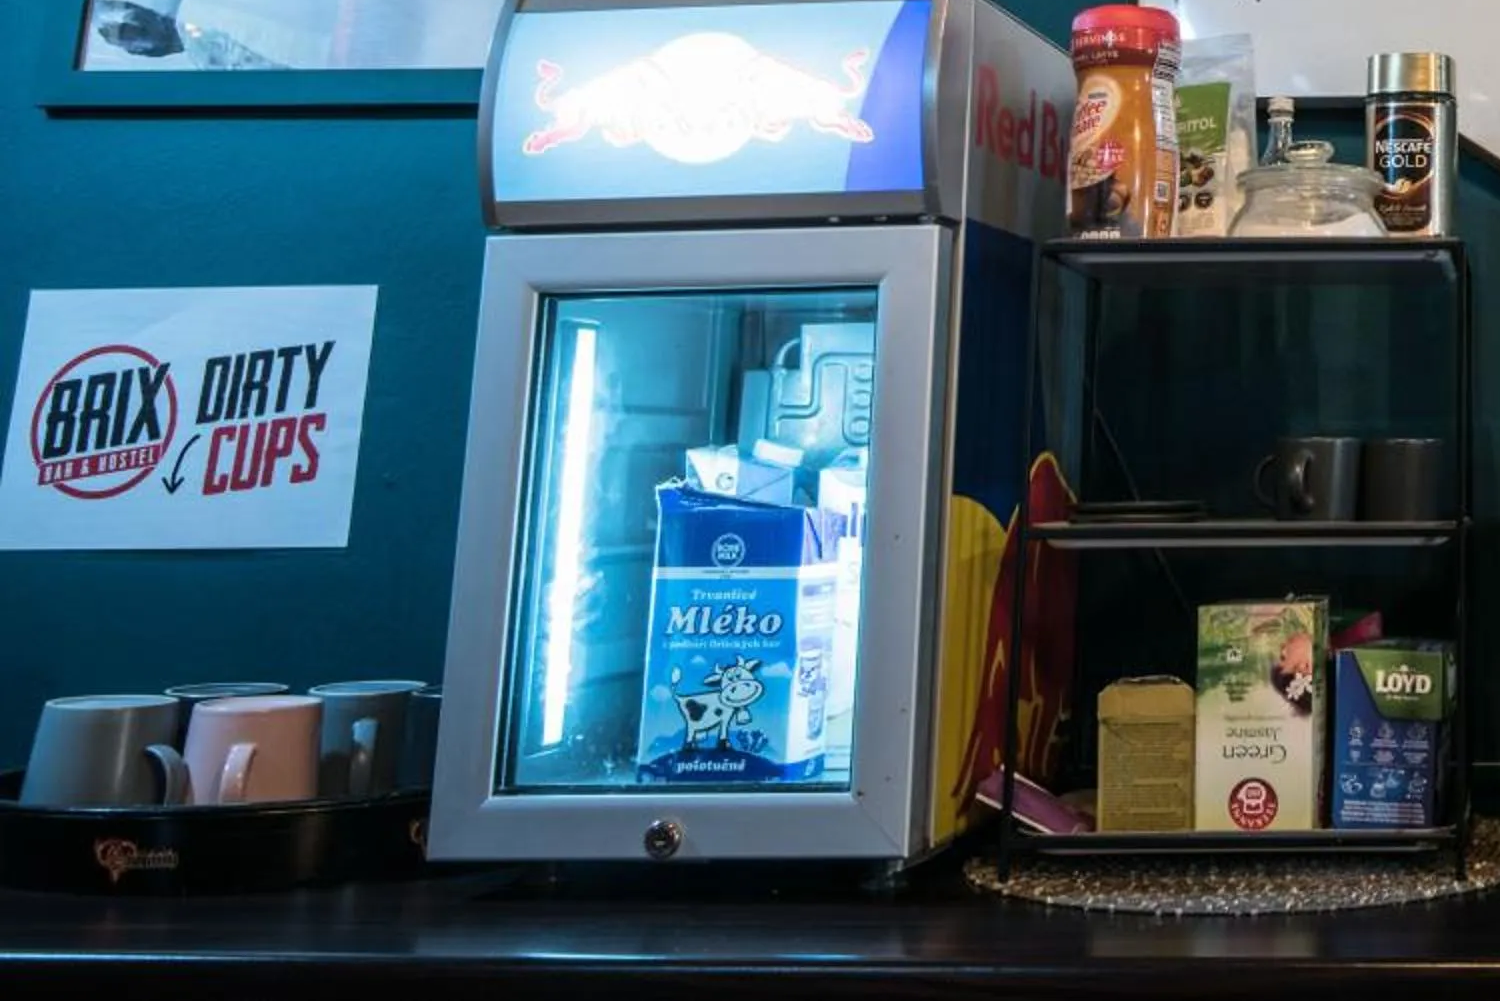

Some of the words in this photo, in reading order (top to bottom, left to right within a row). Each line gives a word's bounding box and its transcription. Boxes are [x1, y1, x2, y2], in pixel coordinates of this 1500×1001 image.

[975, 62, 1037, 170] Red
[1379, 154, 1427, 168] GOLD
[196, 341, 336, 425] DIRTY
[43, 362, 171, 459] BRIX
[43, 462, 73, 483] BAR
[98, 446, 154, 473] HOSTEL
[202, 413, 327, 495] CUPS
[665, 604, 782, 635] Mléko
[1376, 669, 1432, 695] LOYD
[1226, 726, 1282, 741] Jasmine
[1222, 744, 1287, 765] Green
